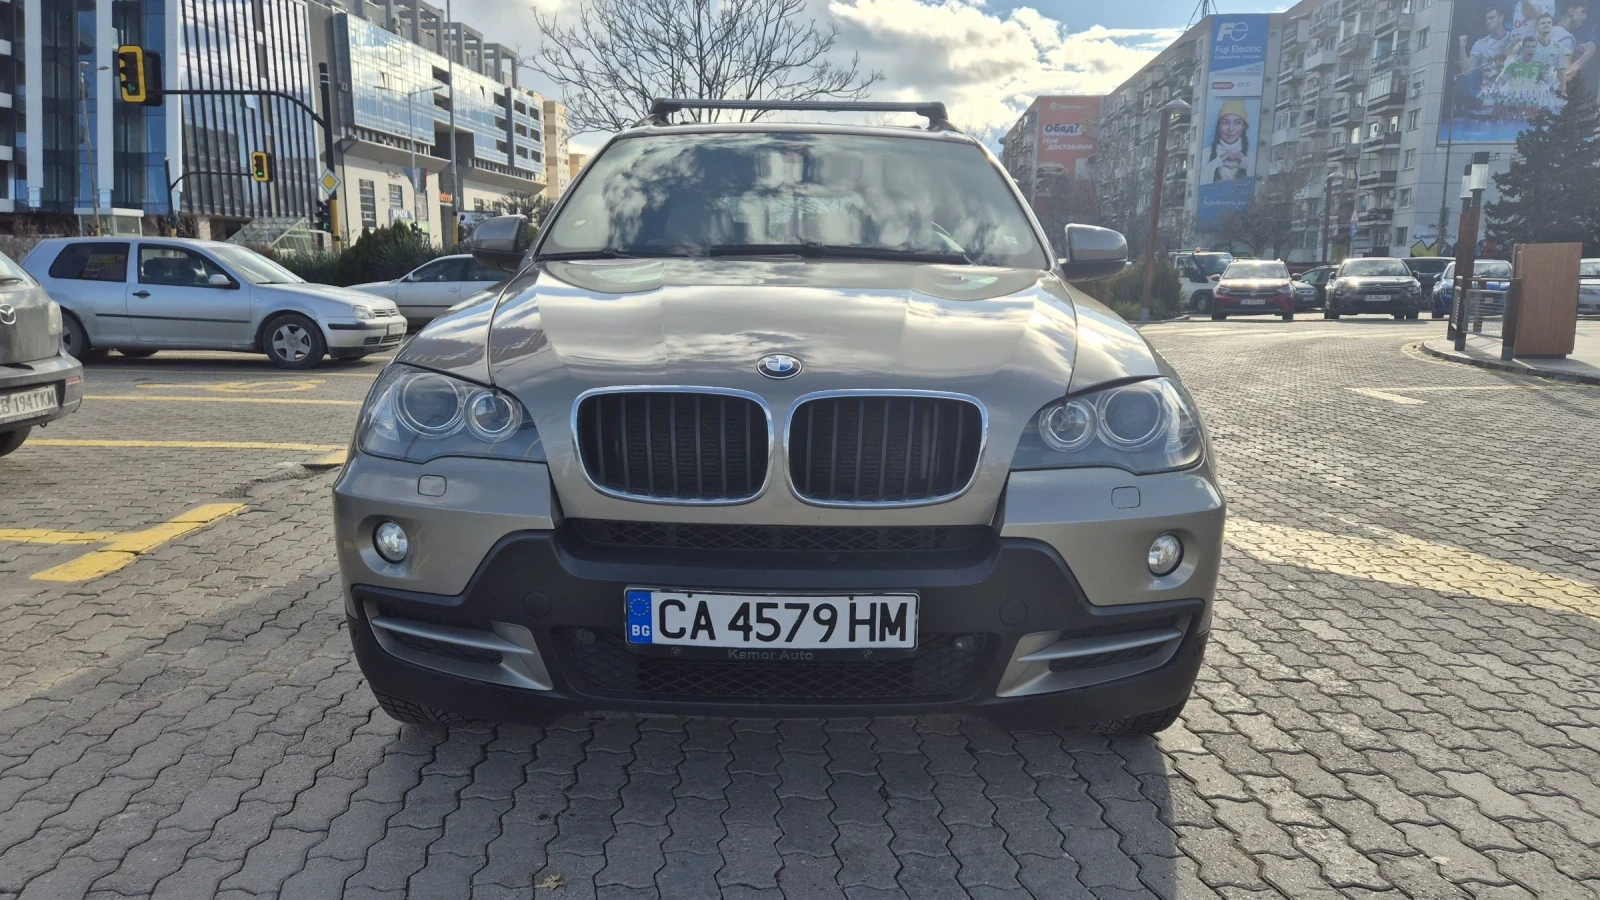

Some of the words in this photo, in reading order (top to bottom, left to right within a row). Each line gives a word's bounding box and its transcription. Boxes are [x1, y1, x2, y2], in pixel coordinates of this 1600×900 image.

[1215, 46, 1230, 54] Fuji
[1231, 45, 1262, 53] Electric
[1044, 123, 1081, 134] Обяд?
[1046, 143, 1093, 151] доставяме
[0, 398, 11, 415] B
[40, 390, 56, 407] KM
[659, 599, 716, 641] CA
[728, 602, 838, 643] 4579
[849, 602, 907, 642] HM
[631, 624, 650, 637] BG
[728, 649, 775, 661] Kamor
[780, 649, 813, 661] Auto
